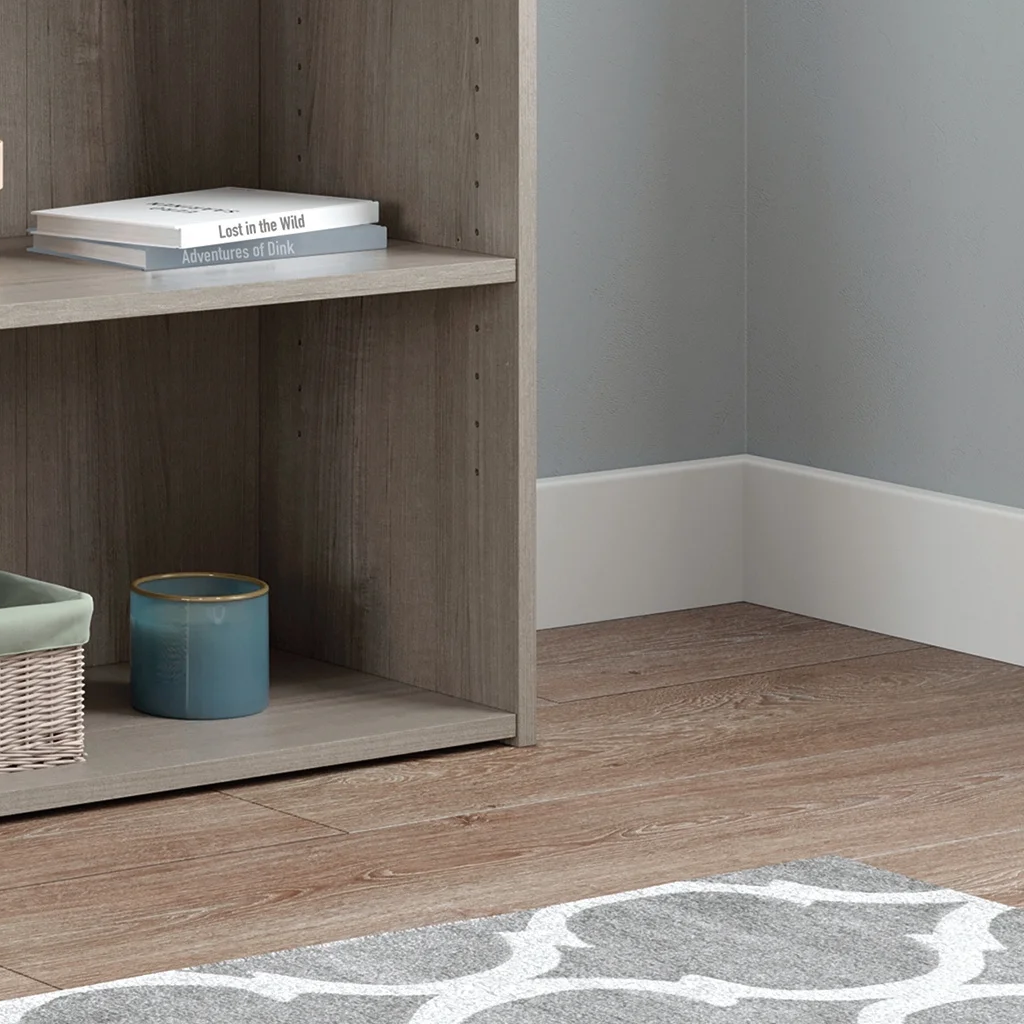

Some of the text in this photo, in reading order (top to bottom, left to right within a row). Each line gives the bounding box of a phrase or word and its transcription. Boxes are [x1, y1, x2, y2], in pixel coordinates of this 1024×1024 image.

[218, 214, 305, 238] Lost in the Wild
[182, 240, 295, 264] Adventures of Dink
